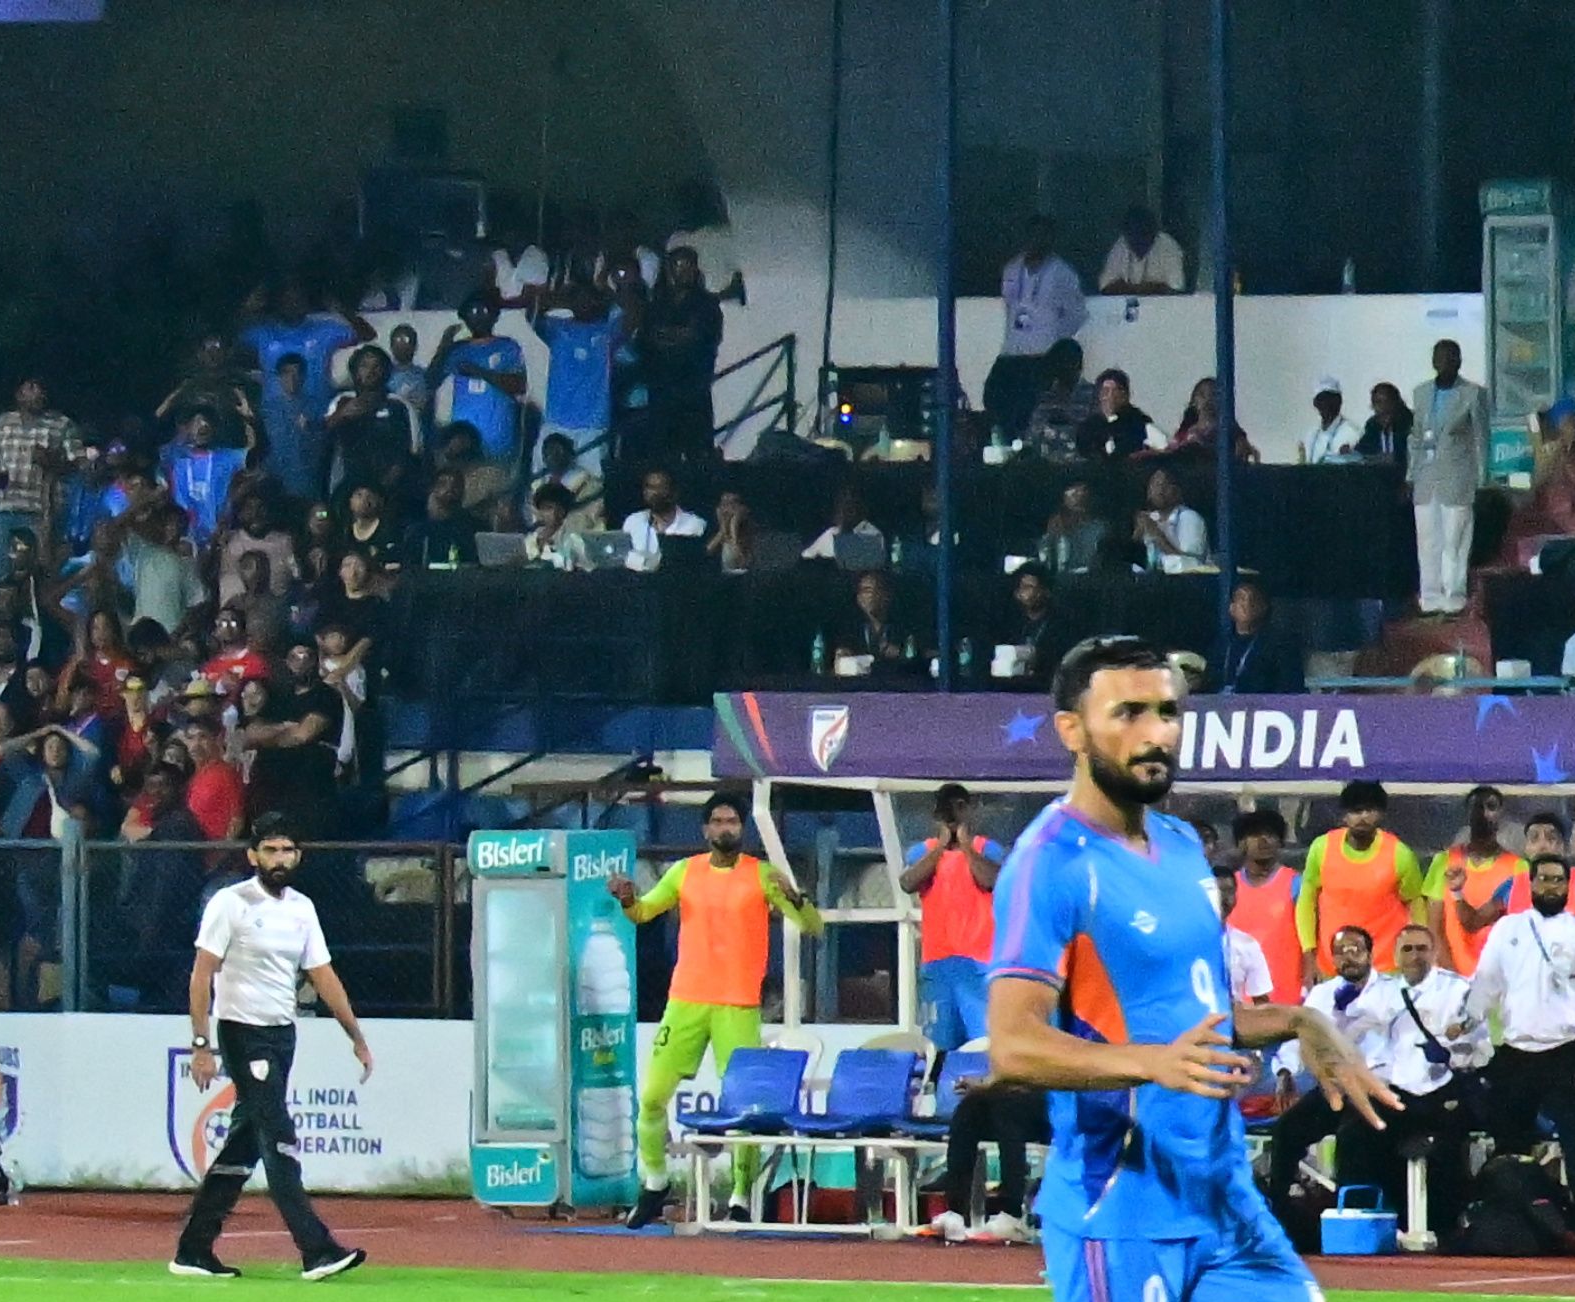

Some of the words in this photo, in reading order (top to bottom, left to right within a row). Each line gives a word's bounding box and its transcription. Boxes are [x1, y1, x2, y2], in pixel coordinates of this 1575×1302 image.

[1180, 709, 1364, 769] INDIA
[478, 837, 545, 869] Bisleri
[574, 848, 629, 881] Bisleri
[1190, 957, 1218, 1013] 9
[308, 1088, 358, 1106] INDIA
[292, 1112, 362, 1130] OTBALL
[294, 1136, 382, 1154] ERATION
